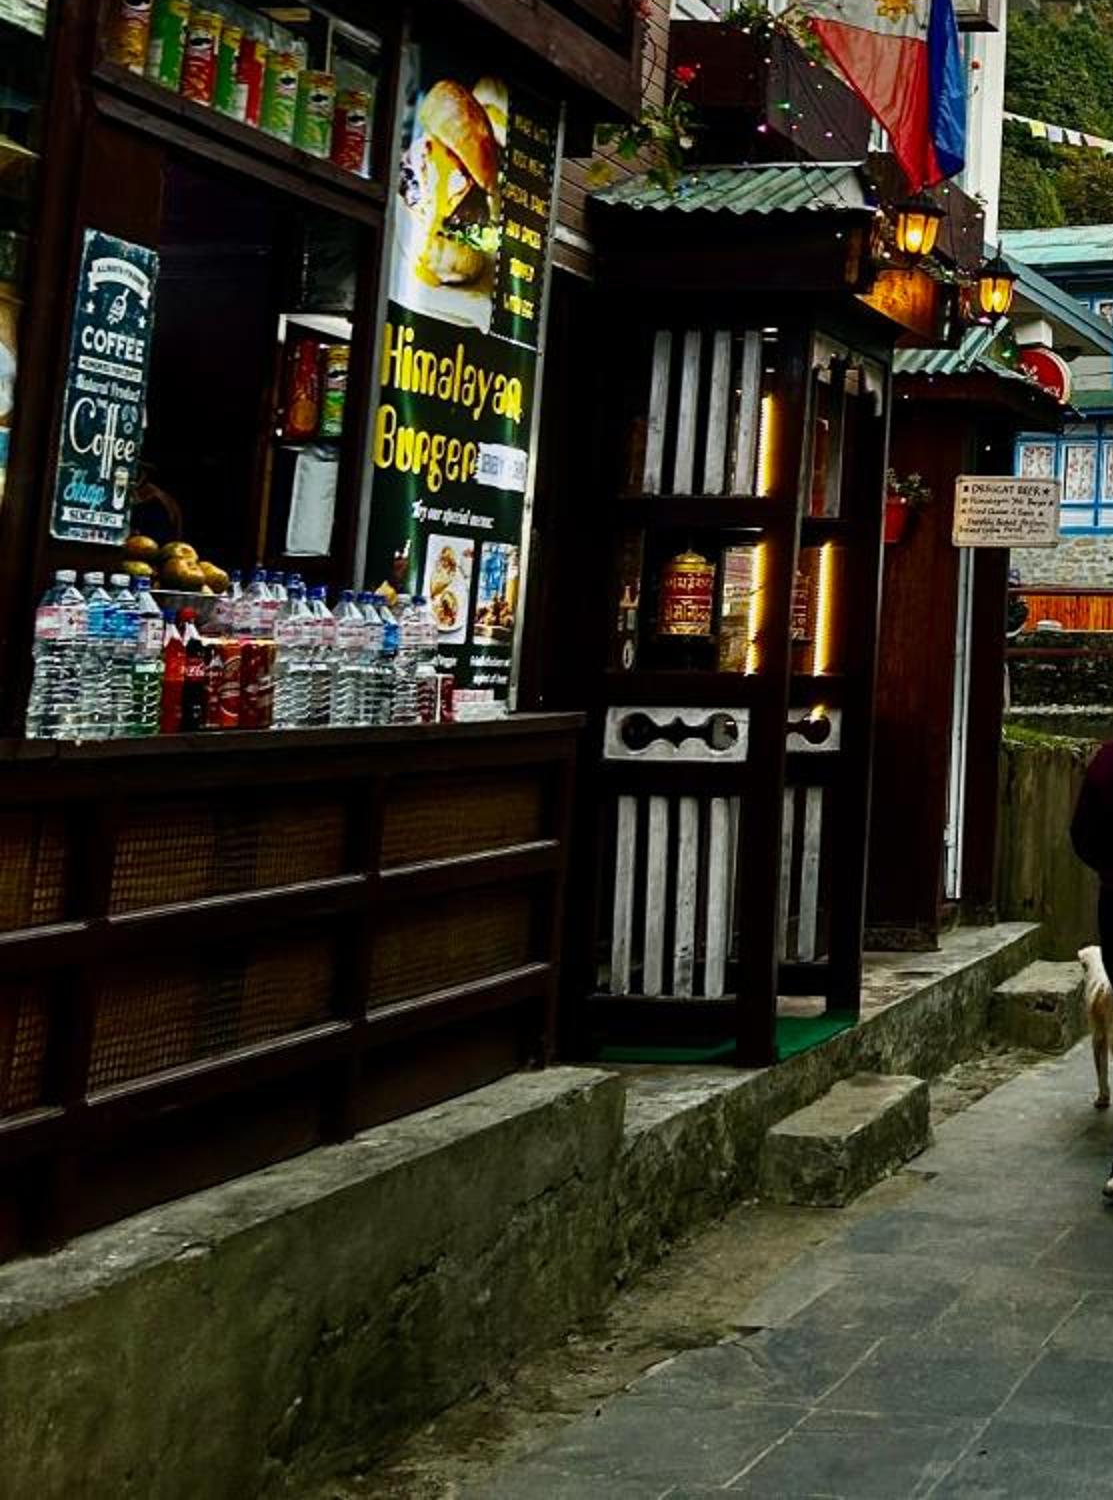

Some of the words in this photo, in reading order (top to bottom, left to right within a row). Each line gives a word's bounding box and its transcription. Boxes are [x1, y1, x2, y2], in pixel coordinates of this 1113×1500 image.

[81, 326, 145, 363] COFFEE
[380, 323, 523, 423] Himalayan
[69, 398, 135, 479] Coffee
[374, 403, 478, 493] Burger
